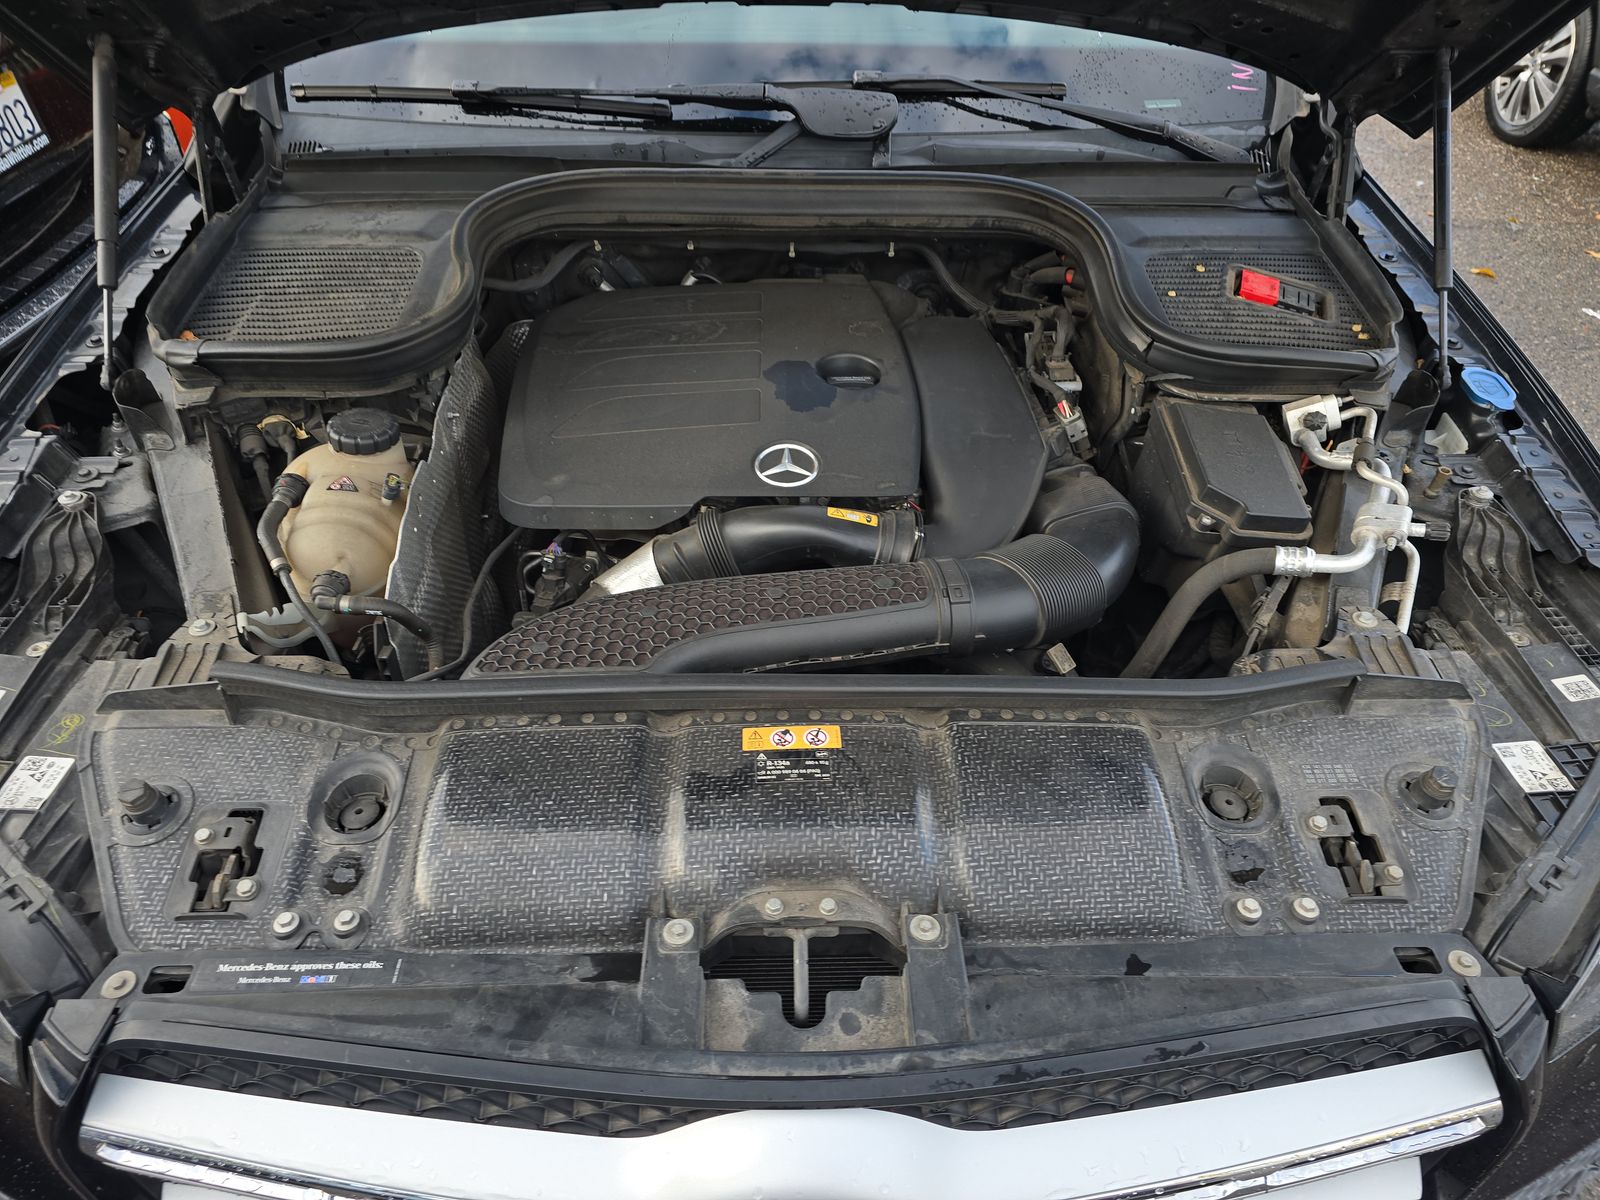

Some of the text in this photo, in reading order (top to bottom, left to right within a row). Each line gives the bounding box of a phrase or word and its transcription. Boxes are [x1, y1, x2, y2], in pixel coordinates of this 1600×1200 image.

[0, 98, 36, 152] 803
[216, 963, 290, 972] Mercedes-Benz
[289, 963, 335, 973] approves
[334, 961, 361, 970] these
[237, 976, 292, 984] Mercedes-Benz
